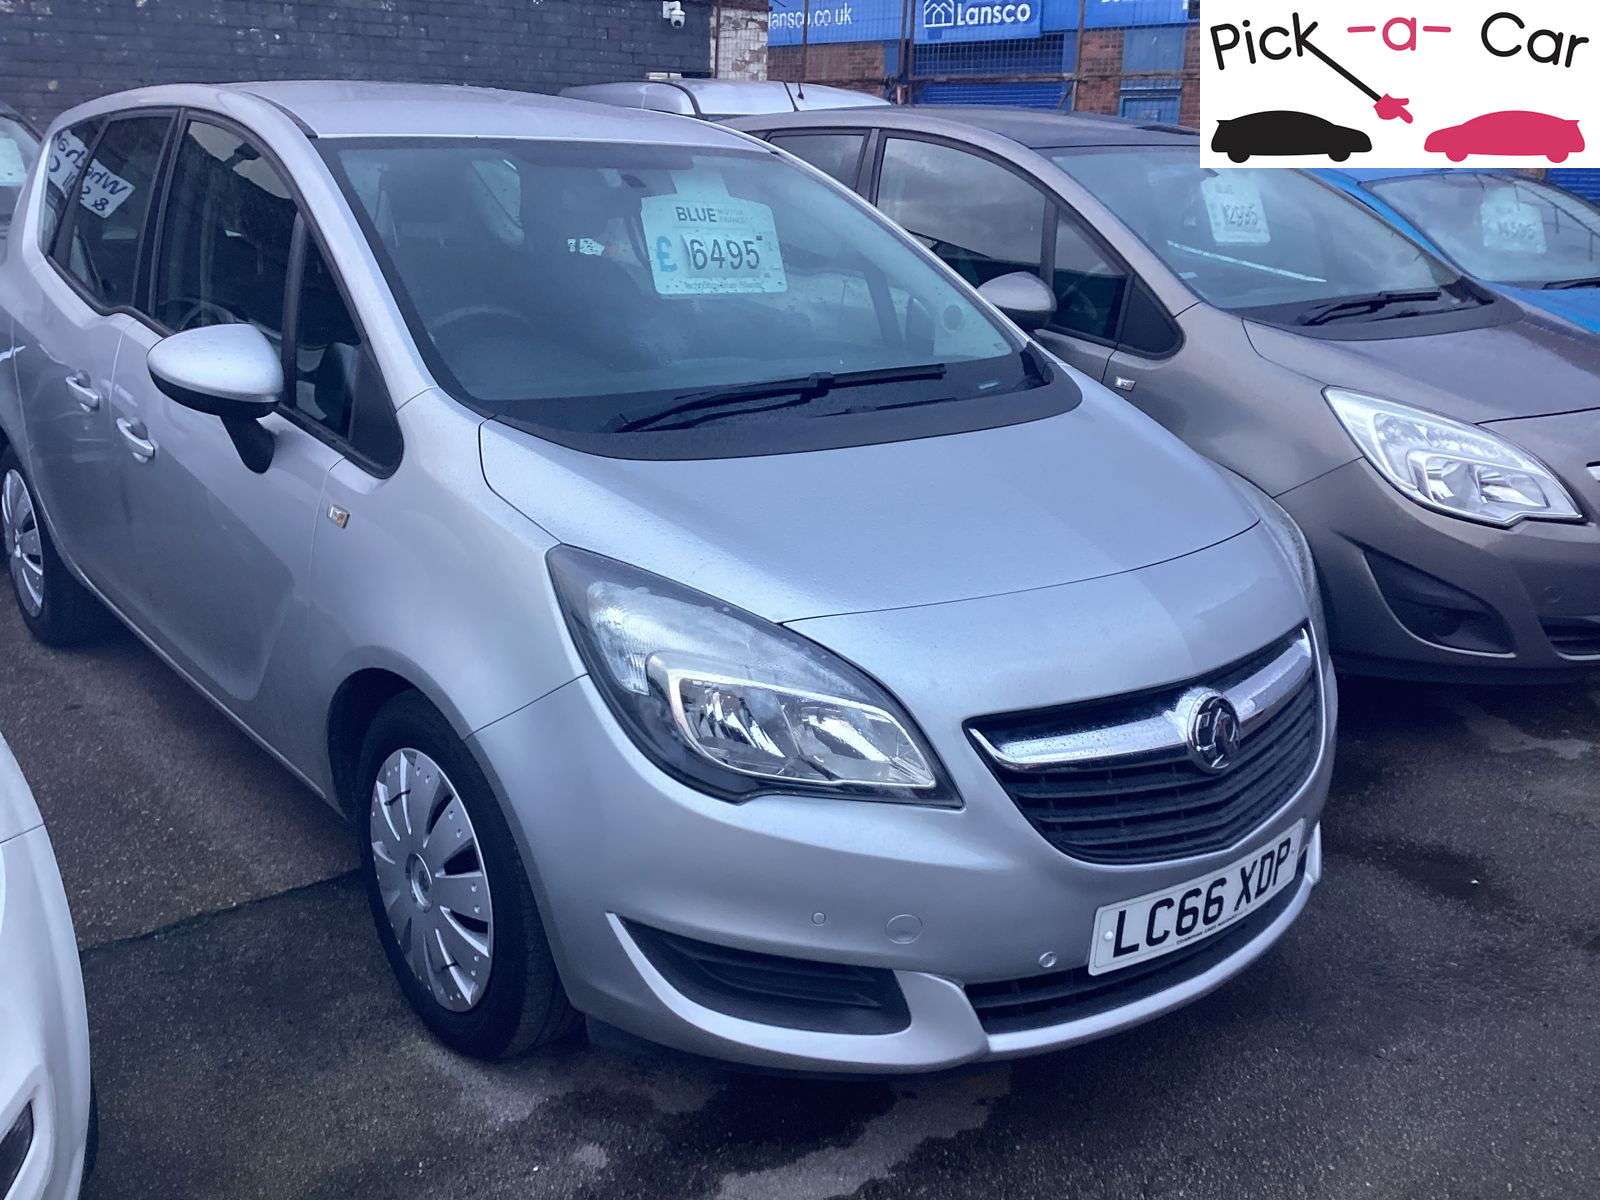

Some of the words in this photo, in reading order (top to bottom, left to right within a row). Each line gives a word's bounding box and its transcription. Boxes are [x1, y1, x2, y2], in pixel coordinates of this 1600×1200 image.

[956, 2, 1031, 26] Lansco
[675, 206, 717, 223] BLUE
[1112, 876, 1228, 958] LC66
[1233, 836, 1292, 912] XDP
